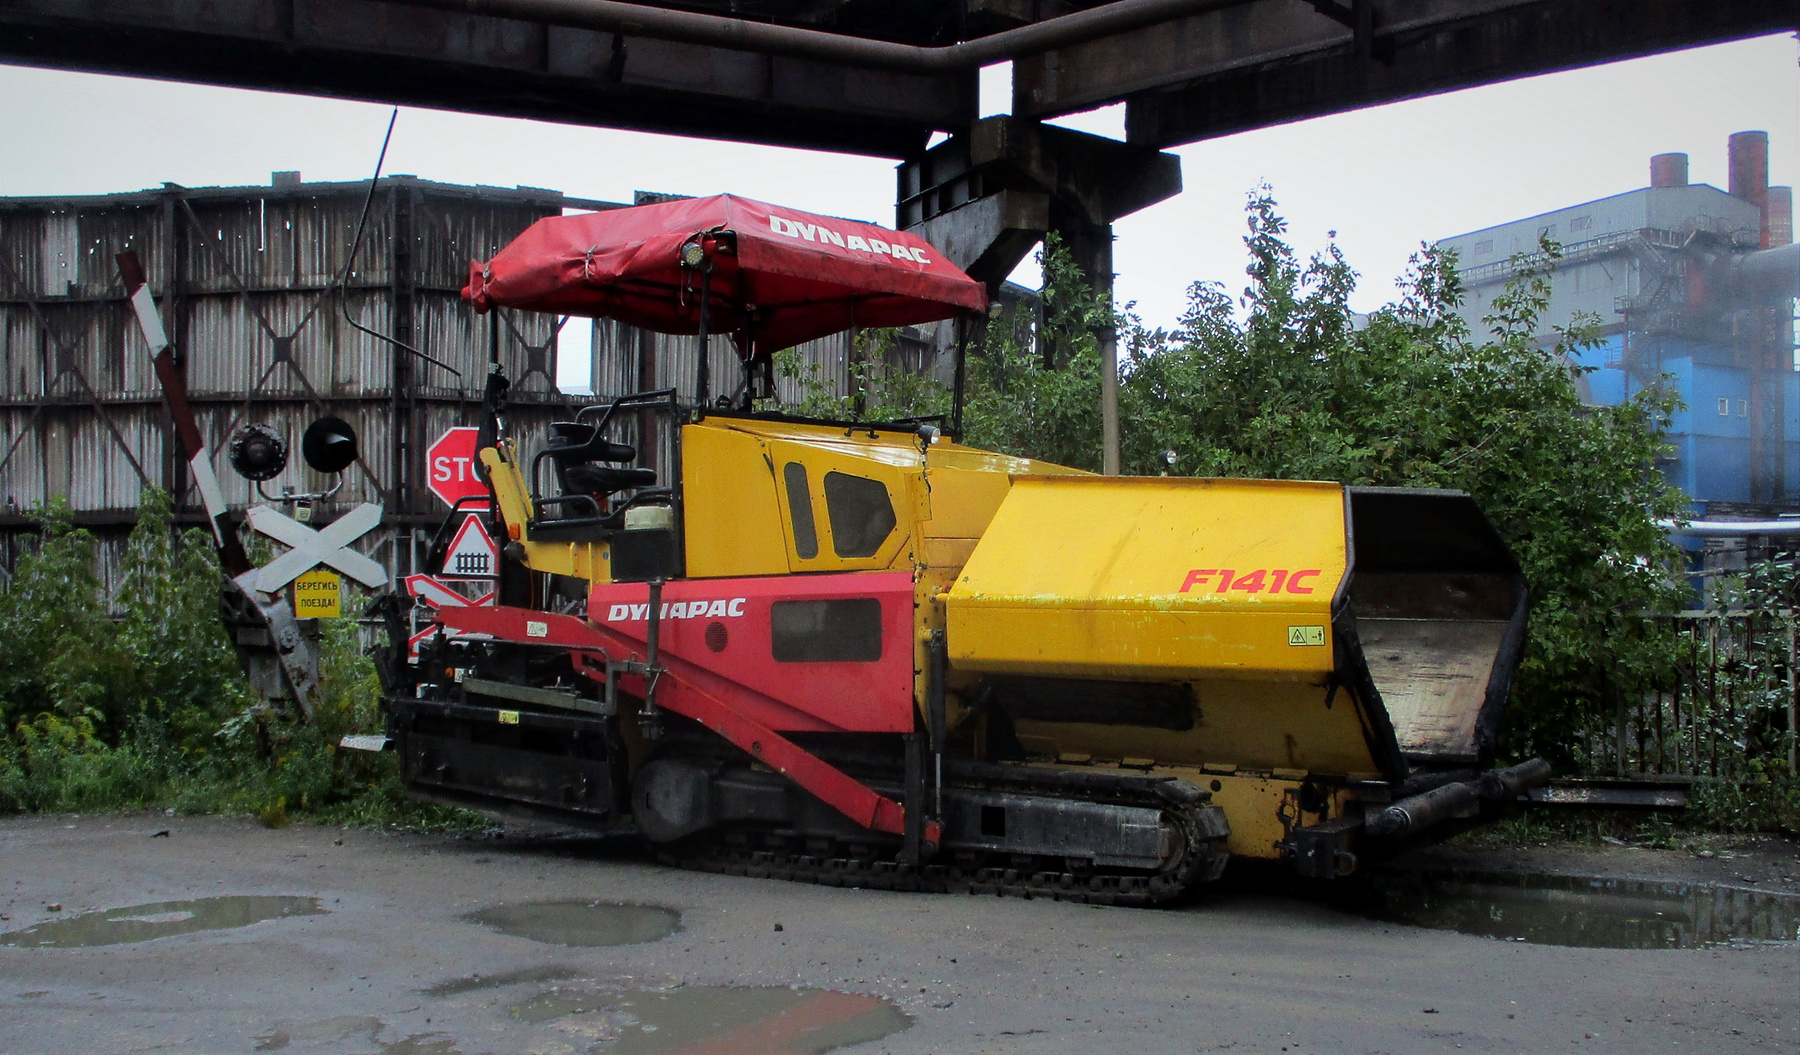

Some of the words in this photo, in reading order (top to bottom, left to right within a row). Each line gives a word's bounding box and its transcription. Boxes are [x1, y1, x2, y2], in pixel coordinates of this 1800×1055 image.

[769, 215, 931, 264] DYNAPAC
[433, 456, 482, 482] ST
[296, 582, 338, 591] БЕРЕГИСЬ
[1179, 569, 1321, 594] F141C
[301, 599, 335, 608] ПОЕЗДА!
